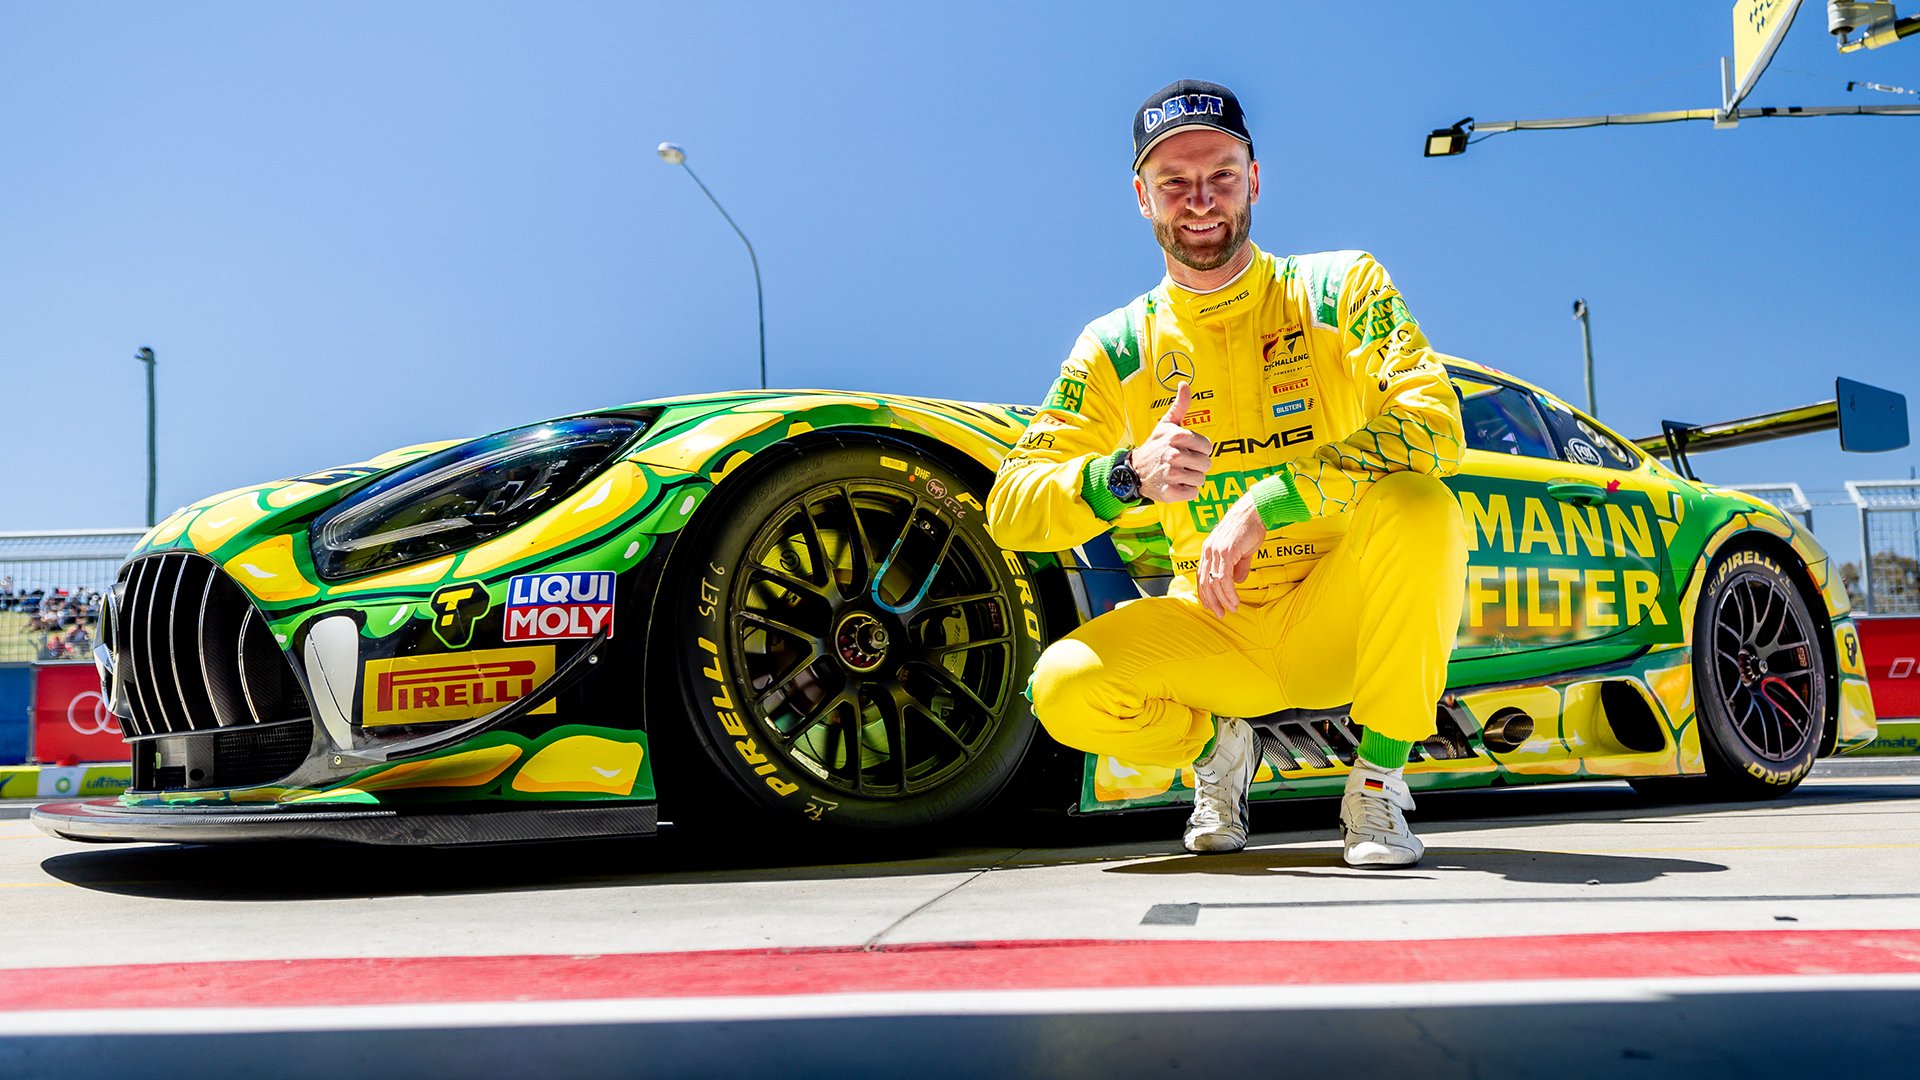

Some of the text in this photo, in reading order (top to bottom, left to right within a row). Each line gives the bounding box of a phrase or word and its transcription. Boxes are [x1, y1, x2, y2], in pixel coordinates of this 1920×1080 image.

[1162, 94, 1224, 122] BWT
[1216, 290, 1250, 309] AMG
[1061, 366, 1088, 380] MG
[1272, 378, 1309, 394] PIRELLI
[1276, 402, 1302, 415] BILSTEIN
[1213, 424, 1315, 458] AMG
[914, 466, 931, 481] DHF
[1194, 470, 1285, 503] MA
[1458, 491, 1656, 558] MANN
[1257, 544, 1316, 560] M. ENGEL
[1718, 550, 1781, 584] PIRELLI
[513, 574, 609, 604] LIQUI
[699, 561, 726, 622] SET 6
[983, 522, 1041, 642] ERO
[1468, 565, 1668, 628] FILTER
[509, 606, 613, 638] MOLY
[377, 660, 538, 713] PIRELLI
[698, 637, 799, 797] PIRELLI
